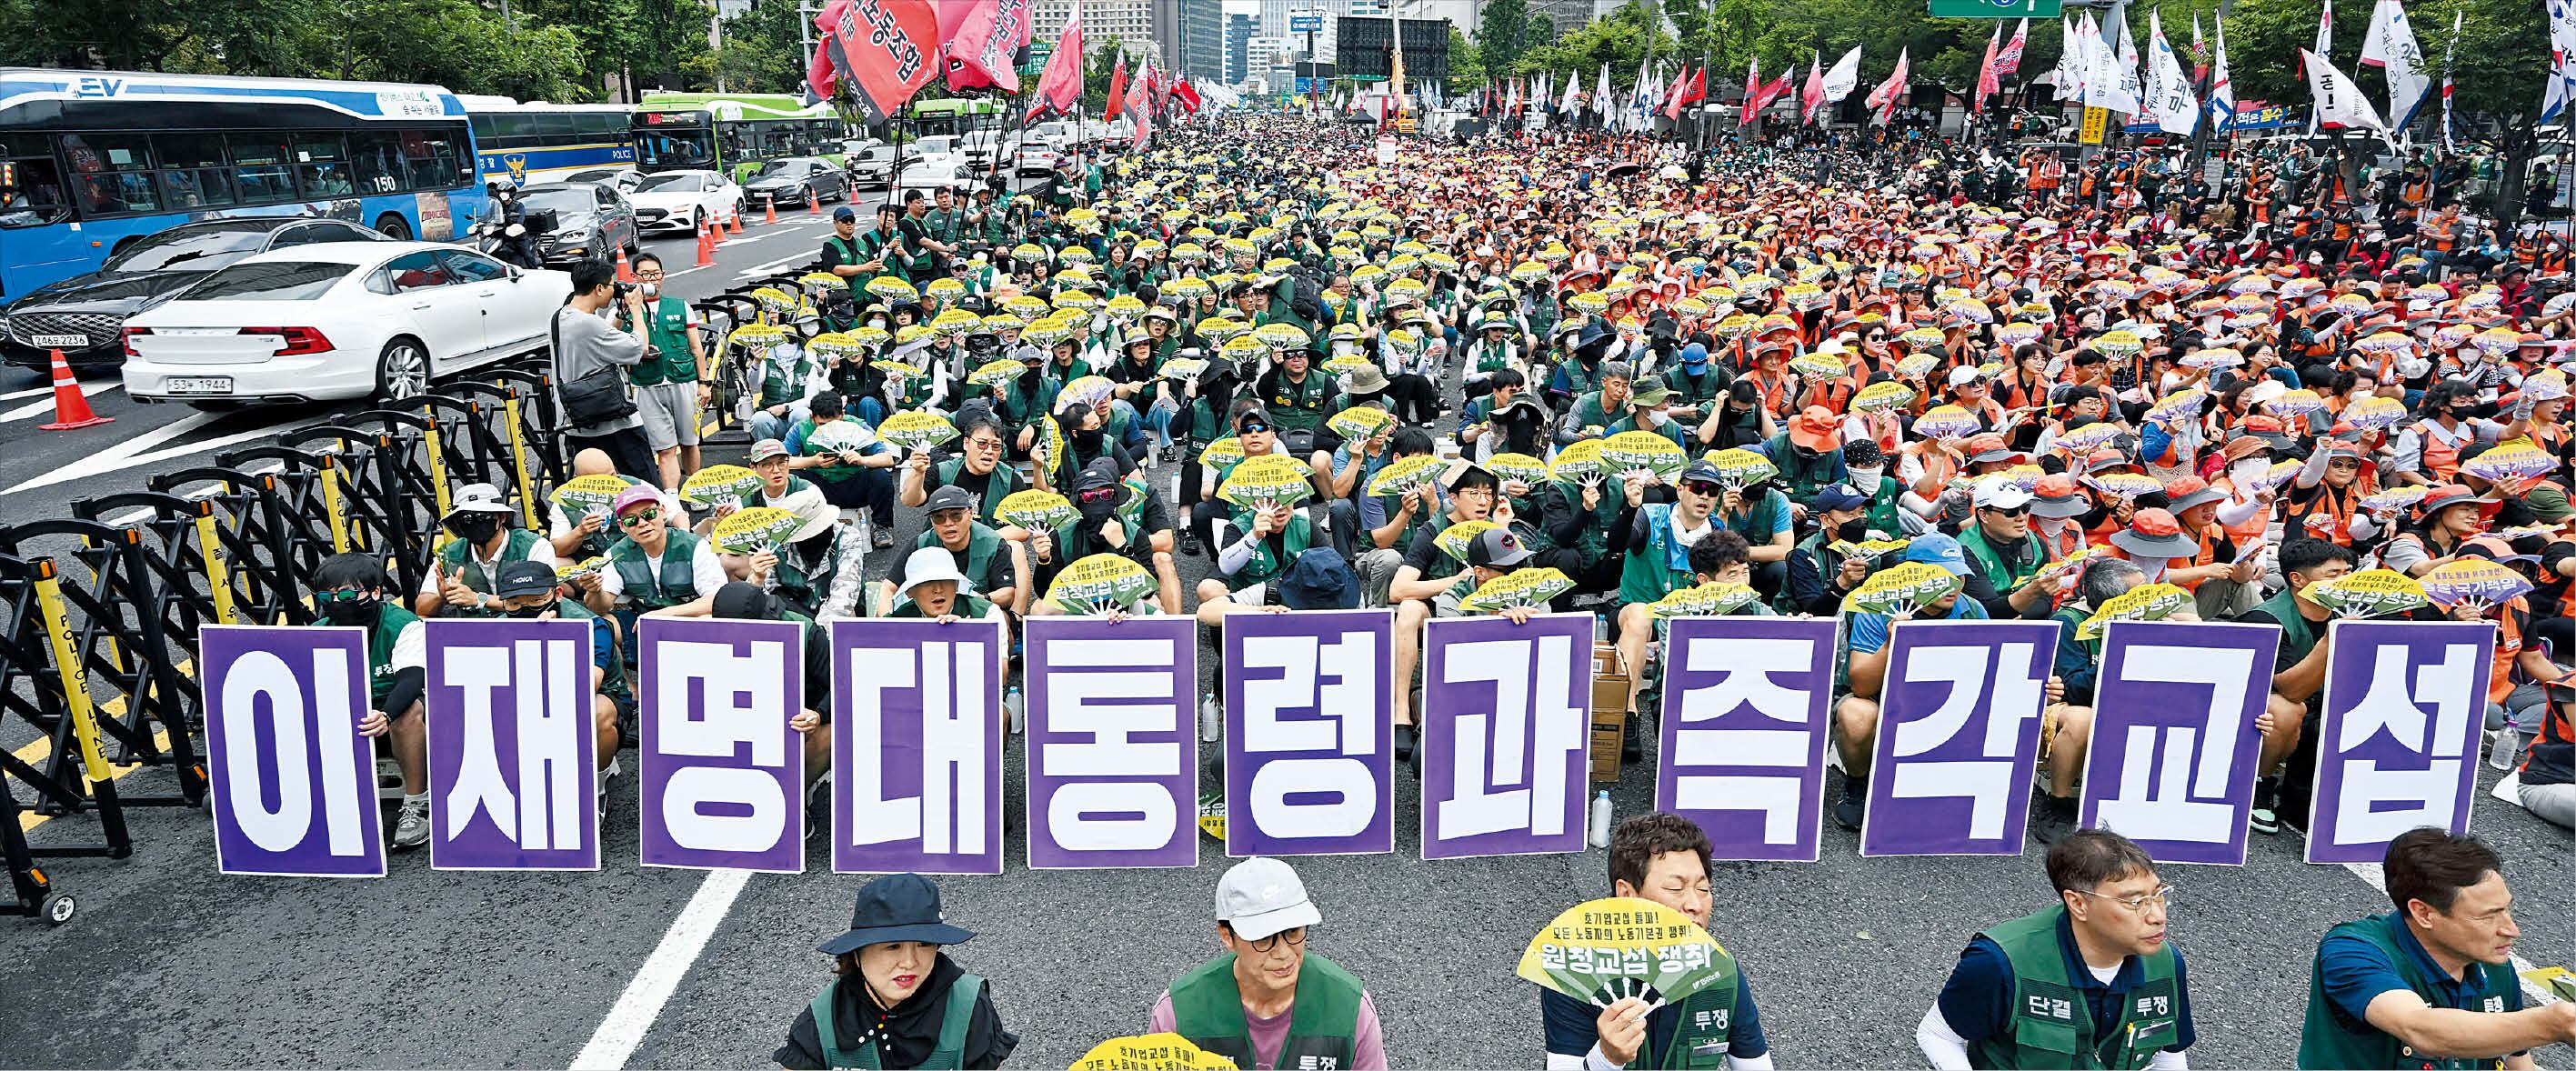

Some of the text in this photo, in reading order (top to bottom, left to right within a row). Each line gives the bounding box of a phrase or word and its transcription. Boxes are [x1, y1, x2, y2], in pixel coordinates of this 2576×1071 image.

[854, 0, 922, 84] 노동조합
[76, 77, 123, 97] EV
[612, 150, 632, 160] POLICE
[374, 175, 396, 193] 150
[199, 379, 226, 390] 1944
[511, 576, 534, 585] HOKA
[1055, 573, 1146, 600] 원청교섭 쟁취
[1854, 576, 1951, 604] 원청교섭 쟁취
[2455, 576, 2519, 595] 국가책임
[60, 614, 106, 759] POLICE LINE
[223, 631, 2477, 856] 이 재 명 대 통 령 과 즉 각 교 섭
[1584, 910, 1660, 925] 초기업교섭 돌파!
[1553, 924, 1693, 942] 모든 노동자의 노동기본권 쟁취!
[1540, 942, 1713, 976] 원청교섭 쟁취
[2029, 995, 2170, 1020] 단결 투쟁
[1695, 1008, 1729, 1032] 투쟁
[1119, 1046, 1196, 1065] 초기업교섭 돌파!
[1298, 1055, 1338, 1070] 투쟁
